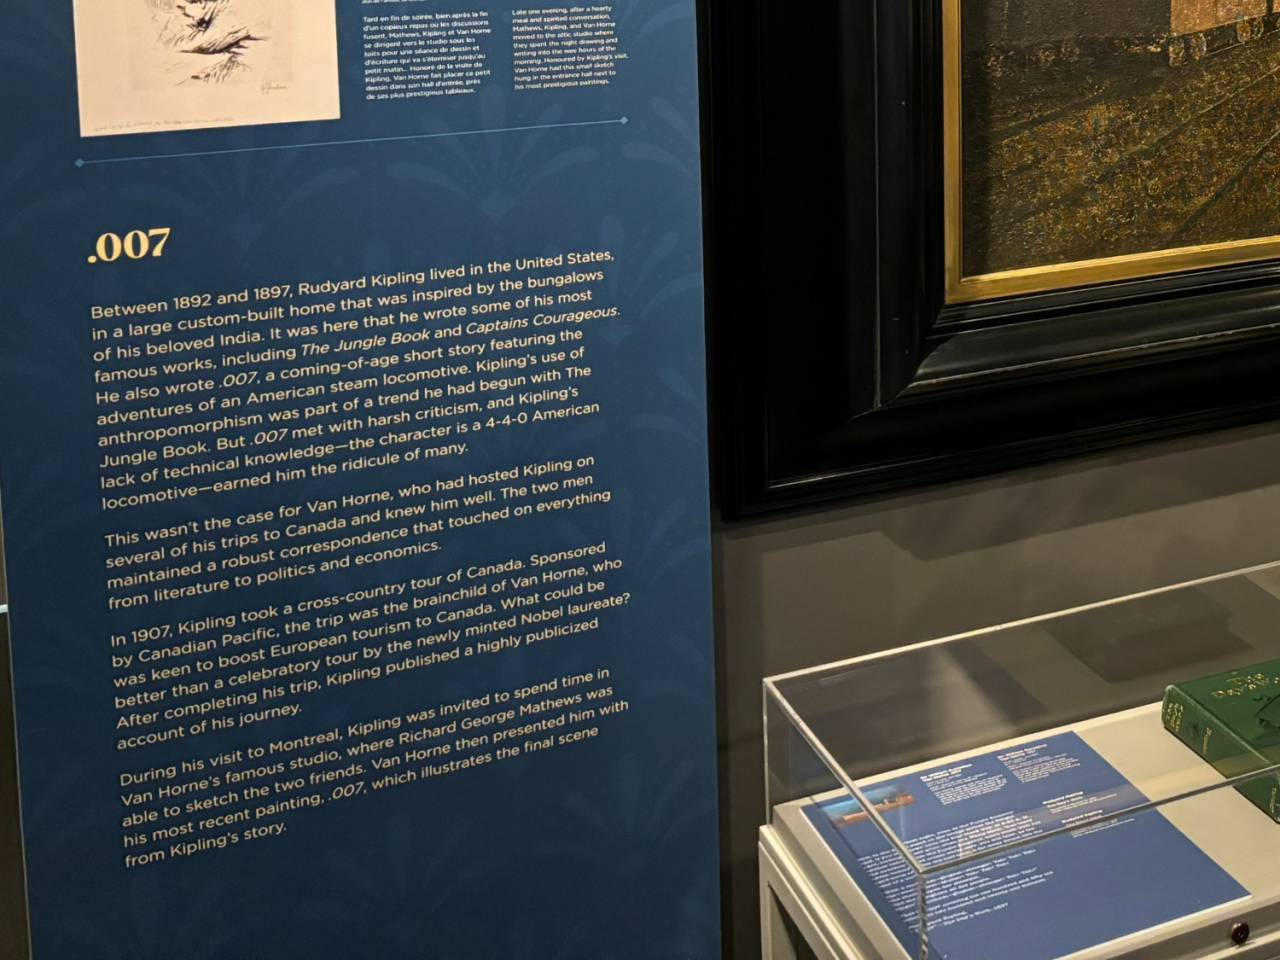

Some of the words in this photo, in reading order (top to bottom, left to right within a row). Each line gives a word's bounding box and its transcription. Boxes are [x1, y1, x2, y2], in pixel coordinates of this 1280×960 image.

[87, 227, 171, 264] .007
[91, 301, 168, 319] Between
[173, 293, 212, 310] 1892
[217, 289, 249, 305] and
[253, 285, 293, 300] 1897,
[298, 276, 367, 295] Rudyard
[371, 271, 425, 287] Kipling
[430, 265, 466, 280] lived
[470, 264, 484, 276] in
[487, 261, 512, 274] the
[515, 253, 563, 271] United
[567, 251, 615, 265] States,
[97, 403, 193, 426] adventures
[198, 397, 216, 411] of
[221, 397, 241, 408] an
[246, 385, 325, 405] American
[330, 377, 378, 393] steam
[383, 365, 472, 386] locomotive.
[476, 353, 537, 373] Kipling's
[541, 351, 566, 363] use
[569, 345, 585, 360] of
[109, 594, 149, 610] from
[154, 579, 230, 602] literature
[234, 575, 252, 587] to
[257, 564, 316, 586] politics
[320, 555, 350, 572] and
[354, 541, 442, 565] economics.
[116, 712, 159, 729] After
[164, 692, 257, 720] completing
[262, 686, 285, 700] his
[289, 679, 322, 694] trip,
[326, 666, 381, 686] Kipling
[385, 646, 460, 676] published
[464, 646, 473, 656] a
[477, 635, 522, 654] highly
[526, 617, 599, 645] publicized
[117, 726, 185, 750] account
[190, 719, 207, 735] of
[211, 716, 235, 730] his
[239, 703, 303, 727] journey.
[121, 792, 153, 806] Van
[158, 776, 221, 799] Horne's
[225, 762, 285, 784] famous
[289, 750, 342, 770] studio,
[346, 738, 395, 756] where
[399, 720, 457, 745] Richard
[461, 710, 516, 730] George
[519, 694, 583, 717] Mathews
[586, 686, 613, 700] was
[125, 850, 165, 868] from
[170, 832, 239, 857] Kipling's
[244, 822, 287, 840] story.
